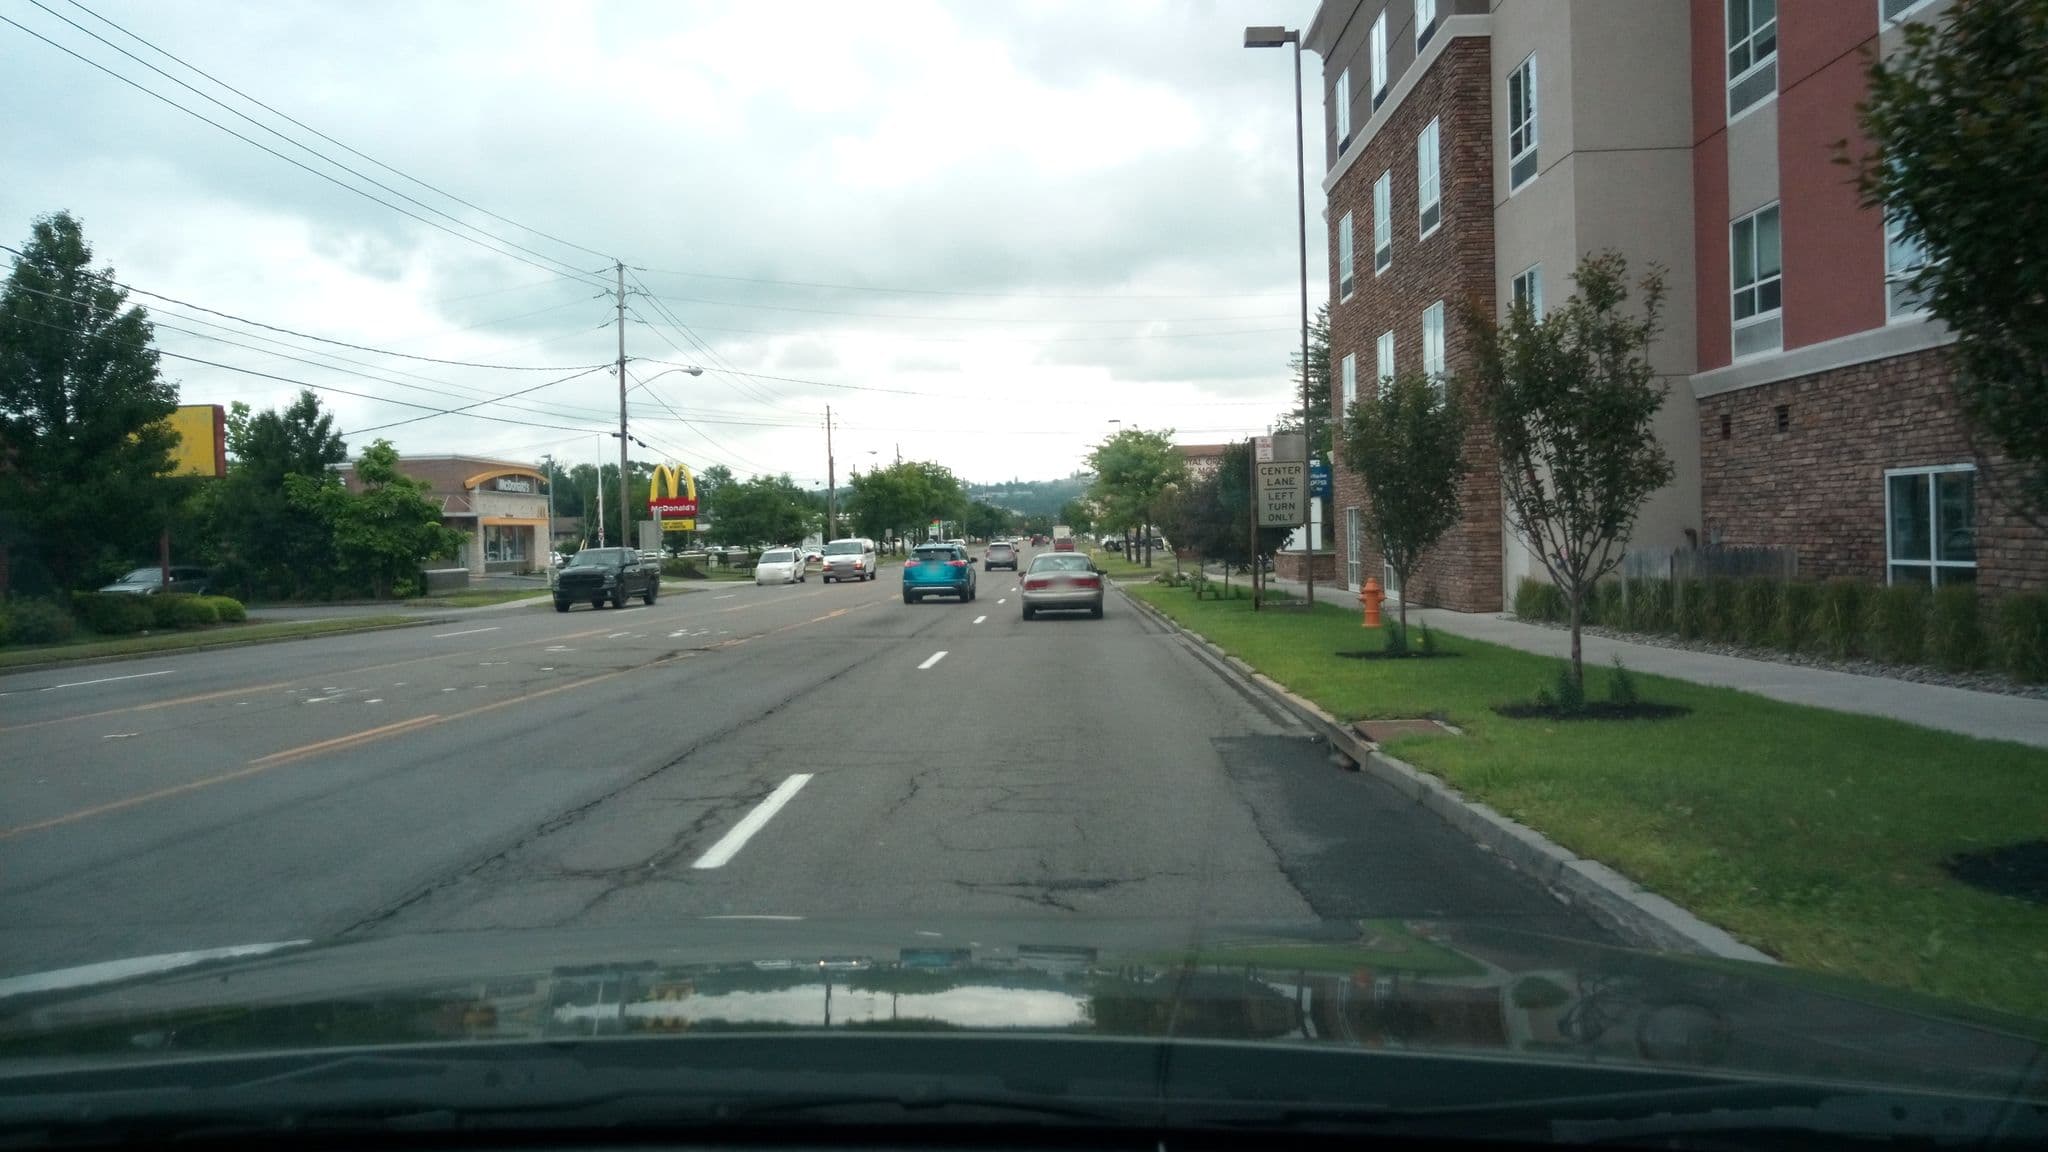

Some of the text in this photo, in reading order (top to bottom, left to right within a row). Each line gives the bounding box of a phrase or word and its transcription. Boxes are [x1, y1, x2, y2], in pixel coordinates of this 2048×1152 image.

[1260, 466, 1301, 476] CENTER
[1266, 477, 1296, 487] LANE
[1268, 491, 1294, 501] LEFT
[650, 504, 696, 512] McDonald's
[1268, 502, 1296, 512] TURN
[1268, 513, 1294, 522] ONLY
